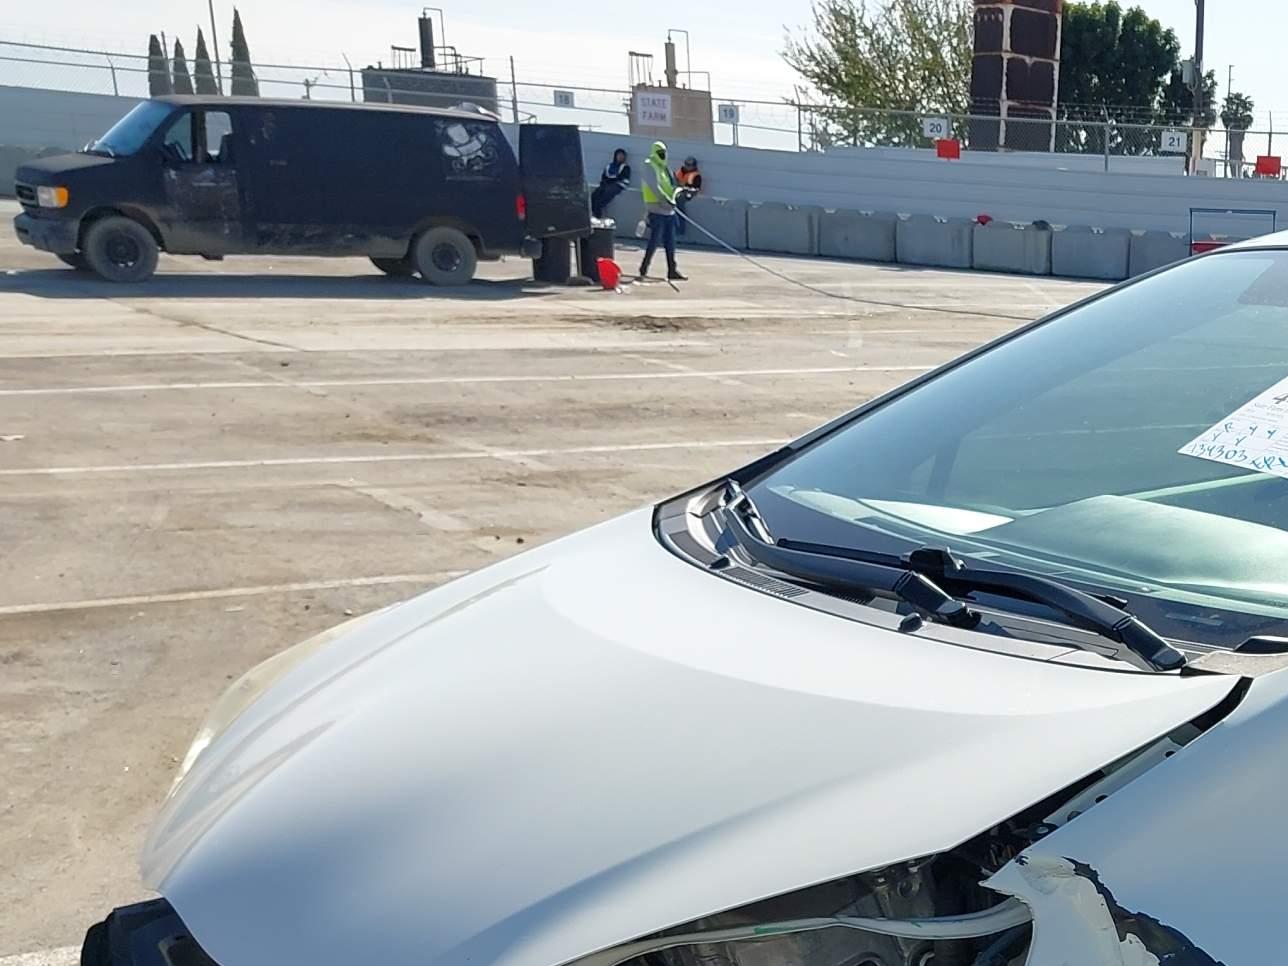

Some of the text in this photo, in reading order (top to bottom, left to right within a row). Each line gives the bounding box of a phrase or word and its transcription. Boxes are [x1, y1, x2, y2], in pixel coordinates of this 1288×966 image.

[641, 97, 668, 108] STATE
[641, 111, 668, 122] FARM
[929, 123, 942, 133] 20
[1168, 137, 1181, 147] 21
